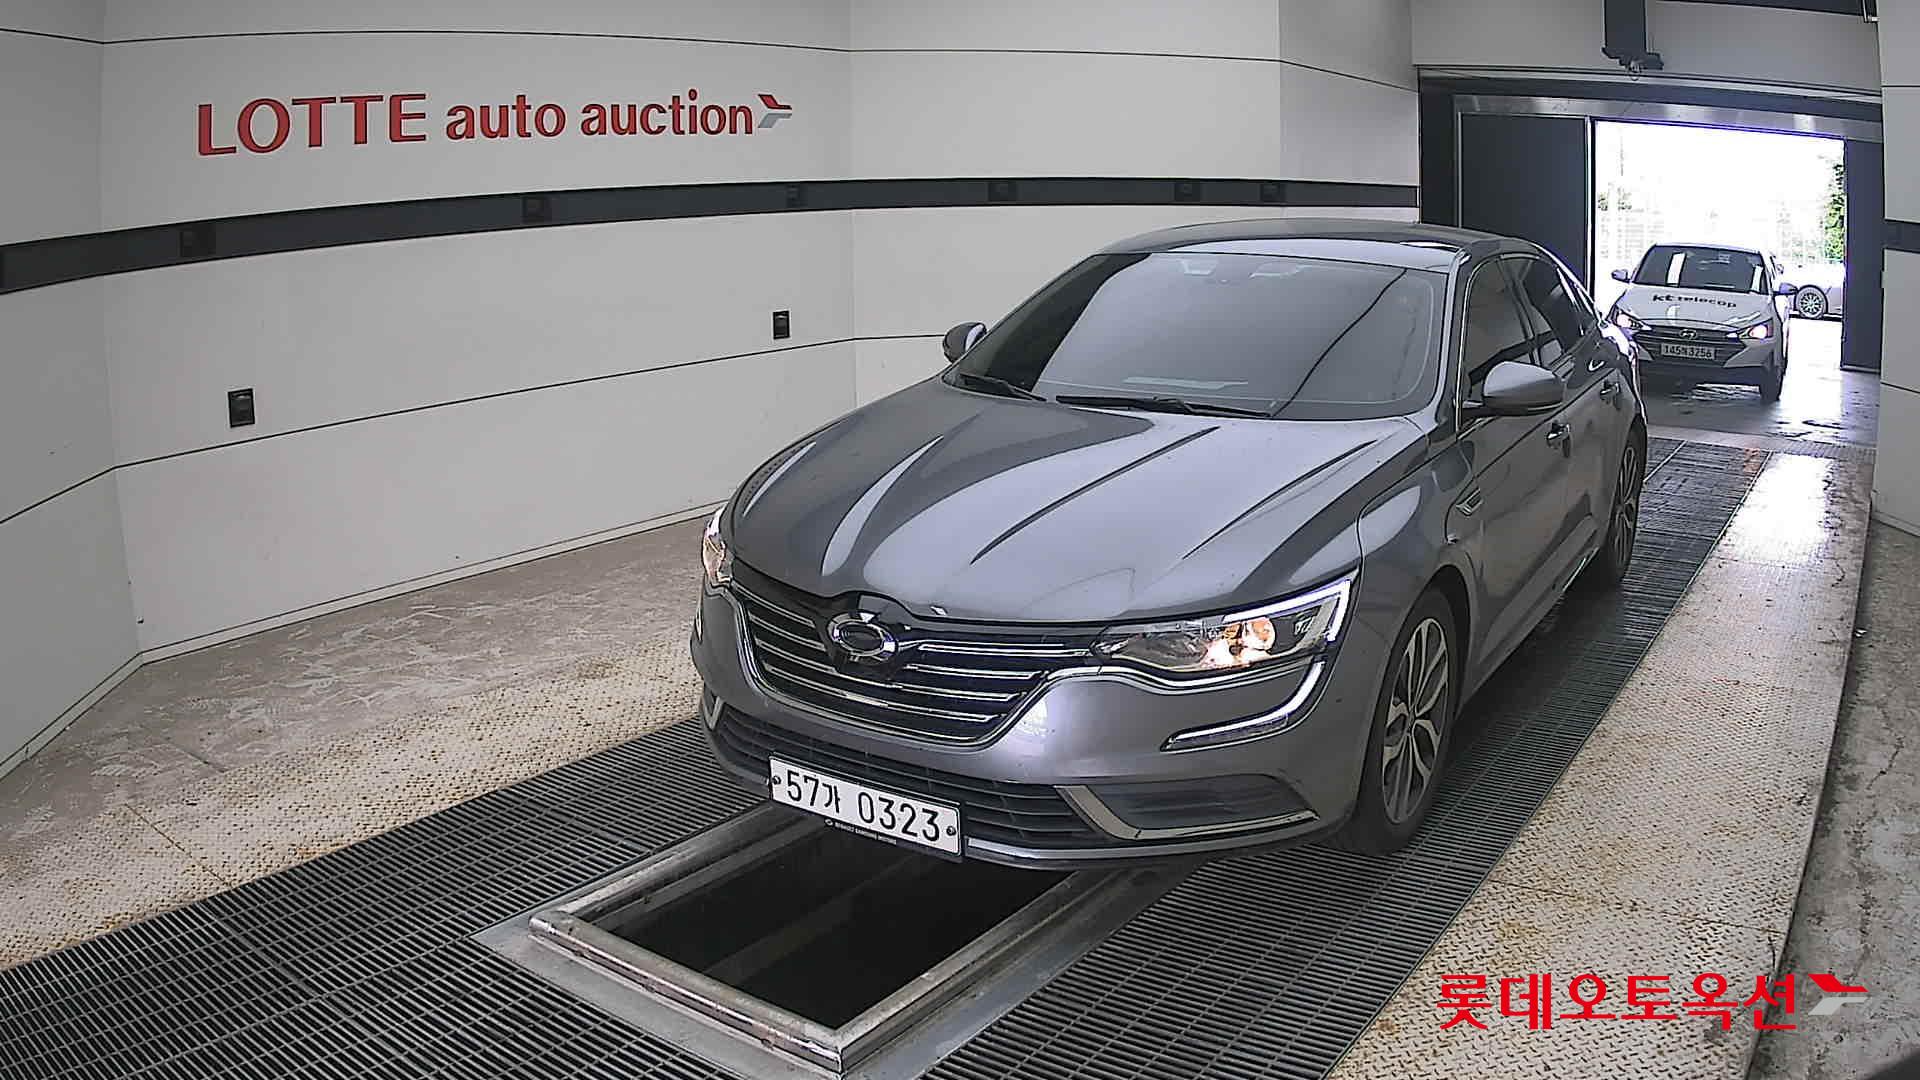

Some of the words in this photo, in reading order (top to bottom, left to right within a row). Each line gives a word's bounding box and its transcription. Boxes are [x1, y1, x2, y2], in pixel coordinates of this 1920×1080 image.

[198, 94, 427, 156] LOTTE
[446, 94, 567, 140] auto
[580, 88, 754, 136] auction
[1652, 294, 1674, 302] kt
[857, 791, 940, 842] 0323
